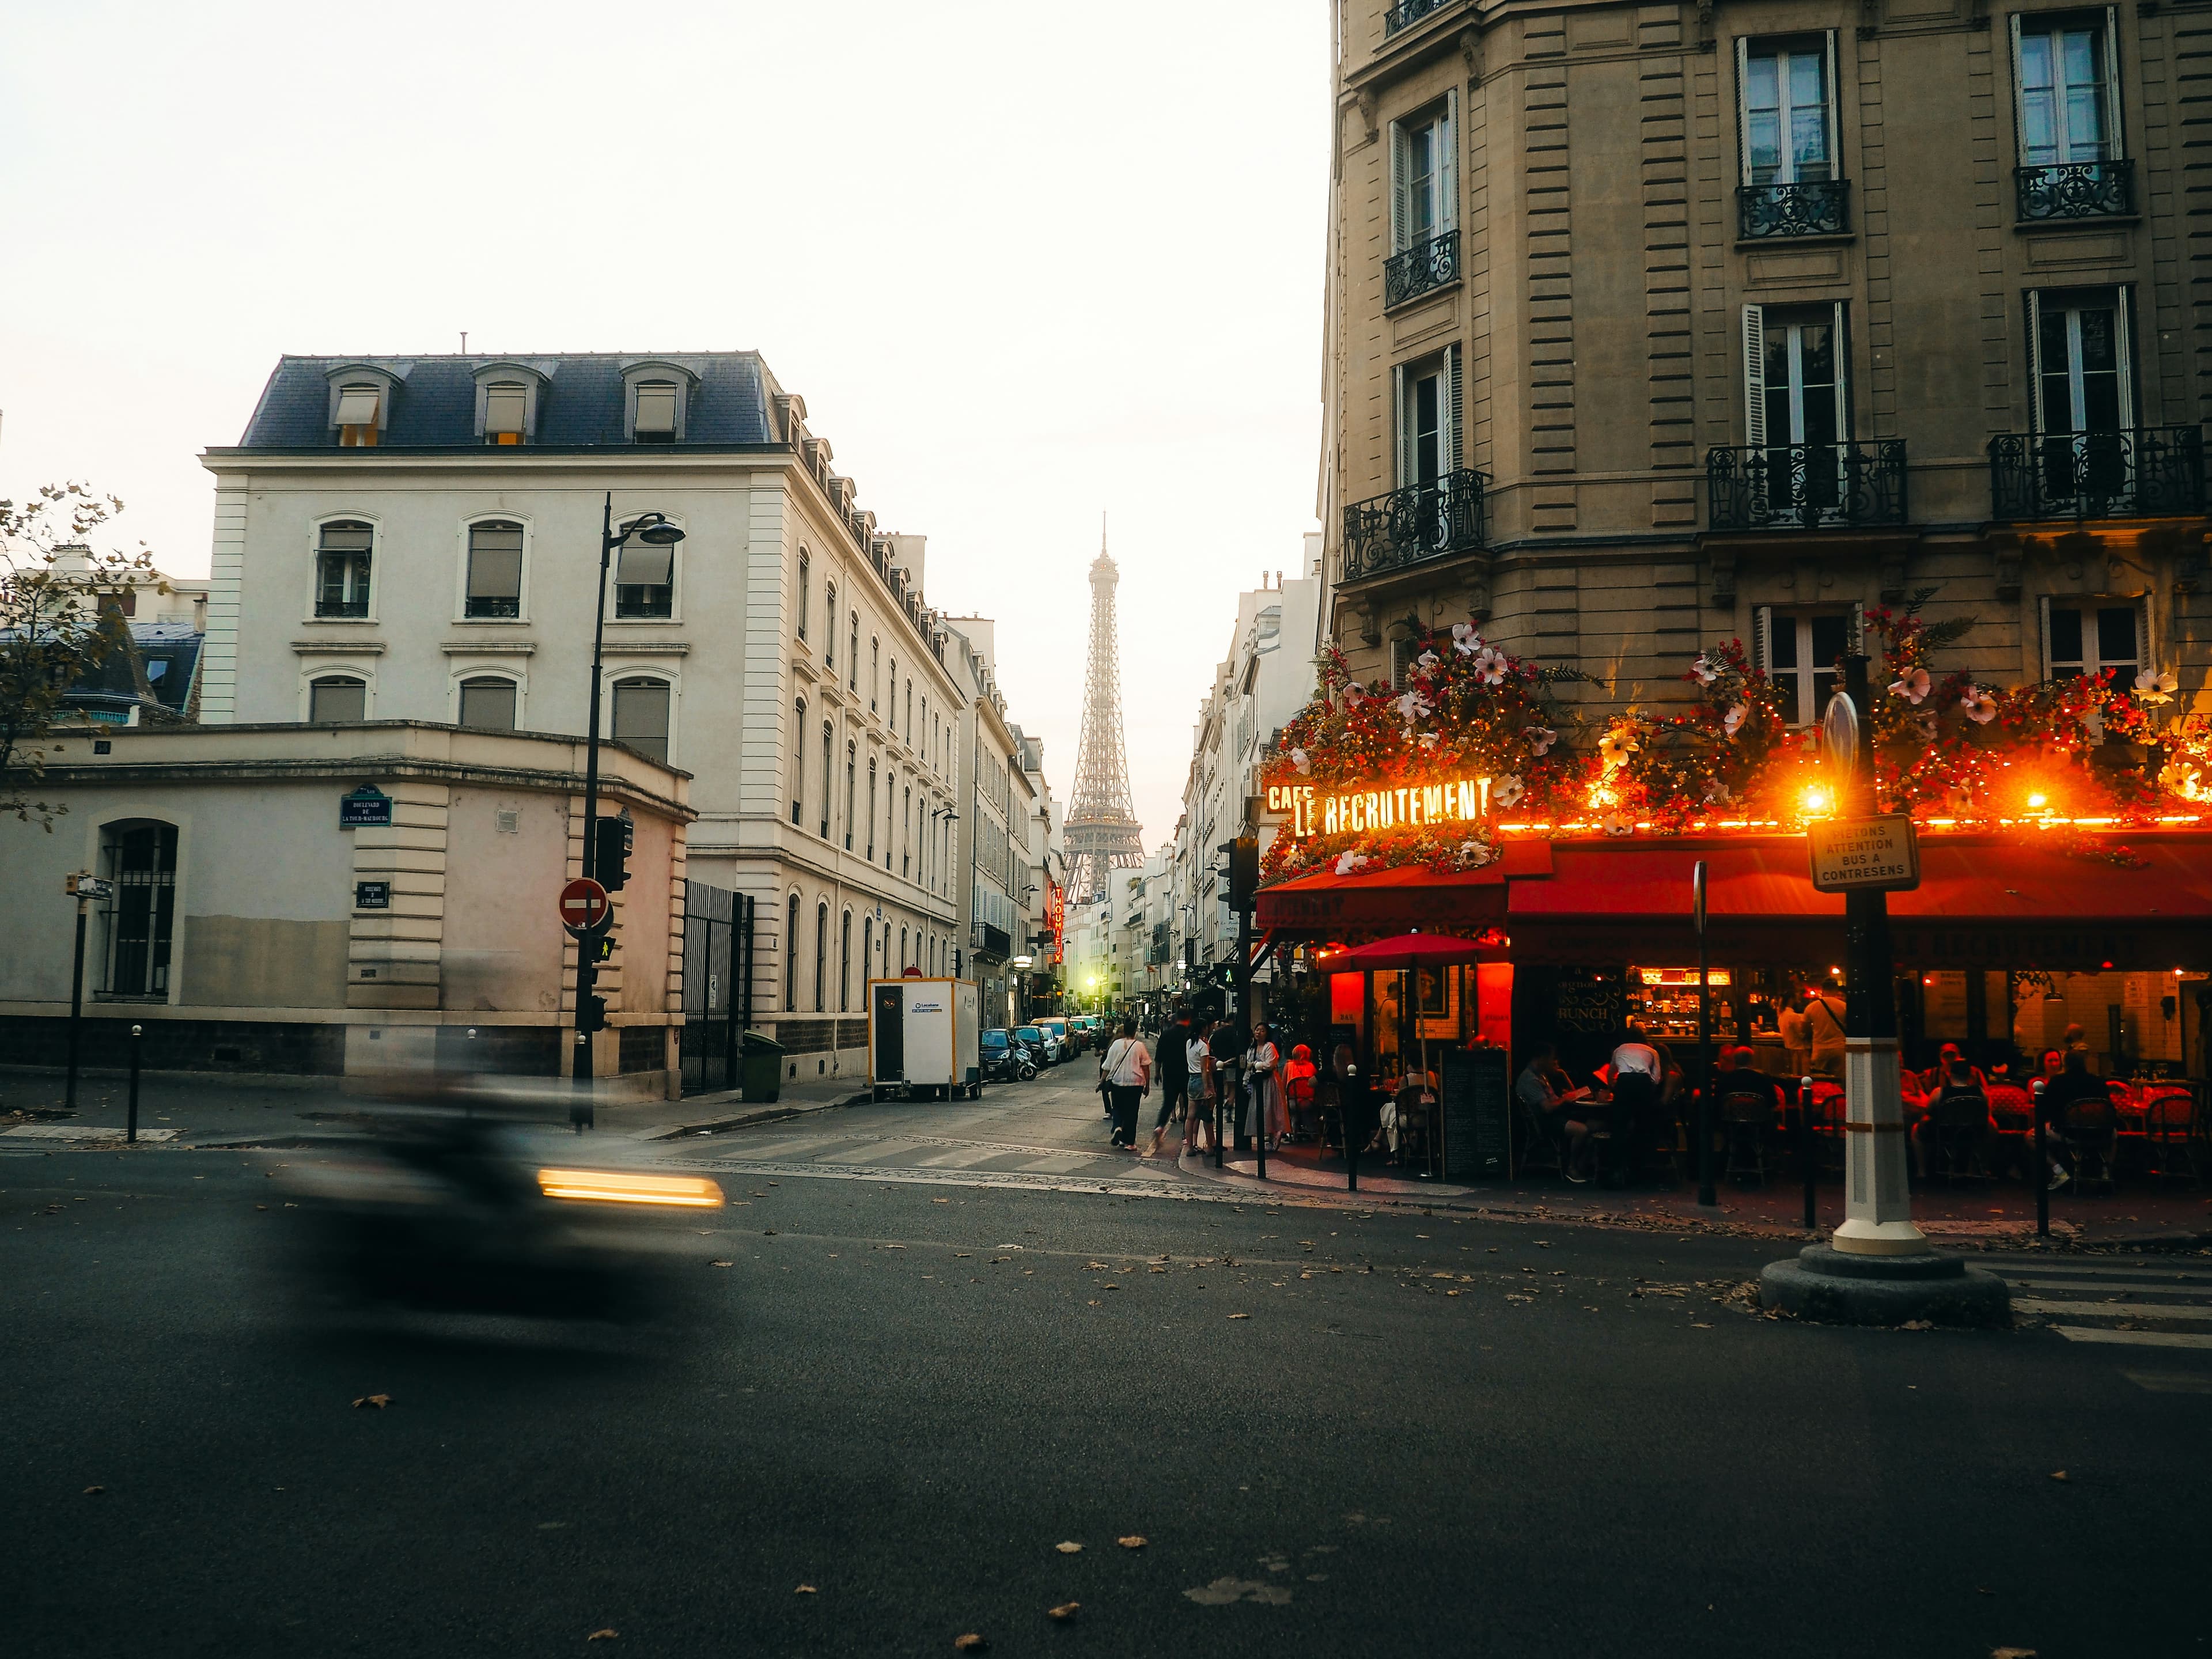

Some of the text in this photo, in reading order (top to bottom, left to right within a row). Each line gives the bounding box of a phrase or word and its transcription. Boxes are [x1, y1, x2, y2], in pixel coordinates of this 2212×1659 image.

[1295, 777, 1492, 838] LE RECRUTEMENT
[1833, 826, 1886, 840] PIETONS
[1827, 838, 1893, 854] ATTENTION
[1843, 854, 1881, 866] BUS A
[1822, 865, 1905, 881] CONTRESENS
[1557, 1007, 1607, 1019] RUNCH
